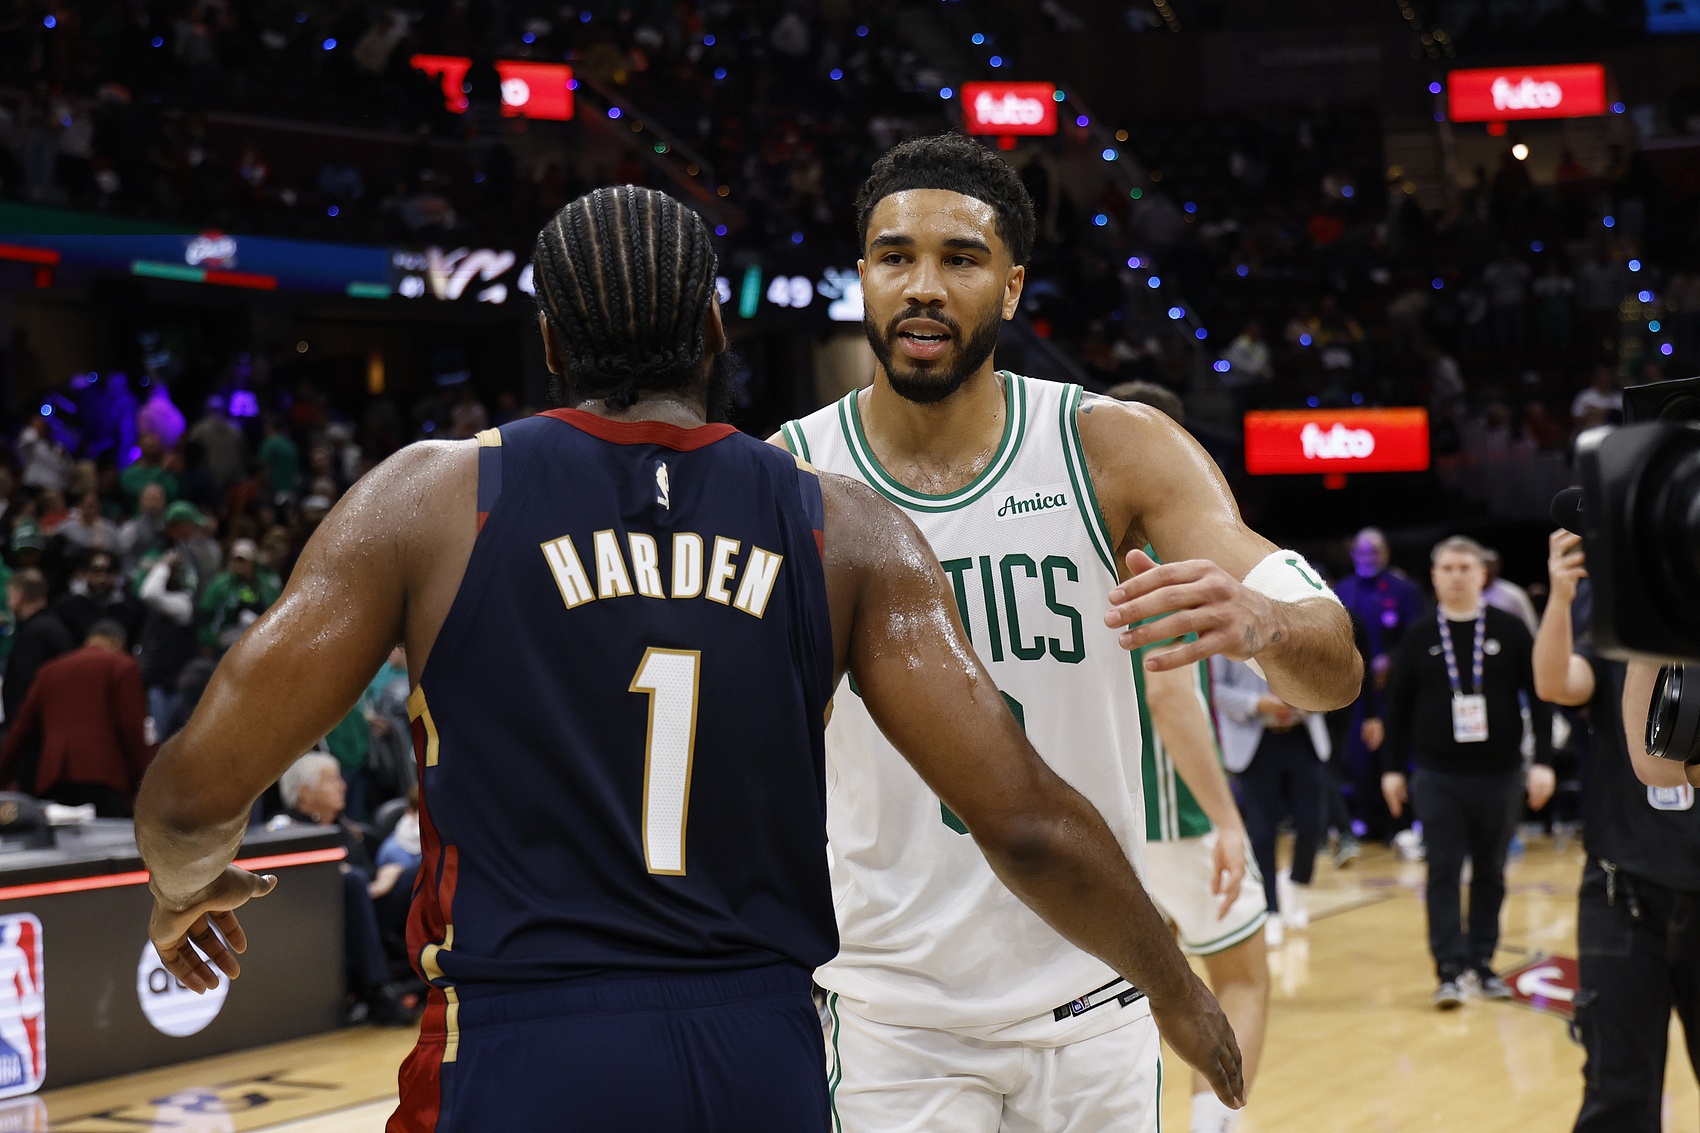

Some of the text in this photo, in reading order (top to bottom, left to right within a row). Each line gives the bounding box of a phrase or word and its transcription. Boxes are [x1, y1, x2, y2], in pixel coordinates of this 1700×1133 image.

[997, 492, 1068, 518] Amica
[540, 528, 784, 620] HARDEN
[940, 553, 1086, 664] TICS
[628, 646, 702, 876] 1
